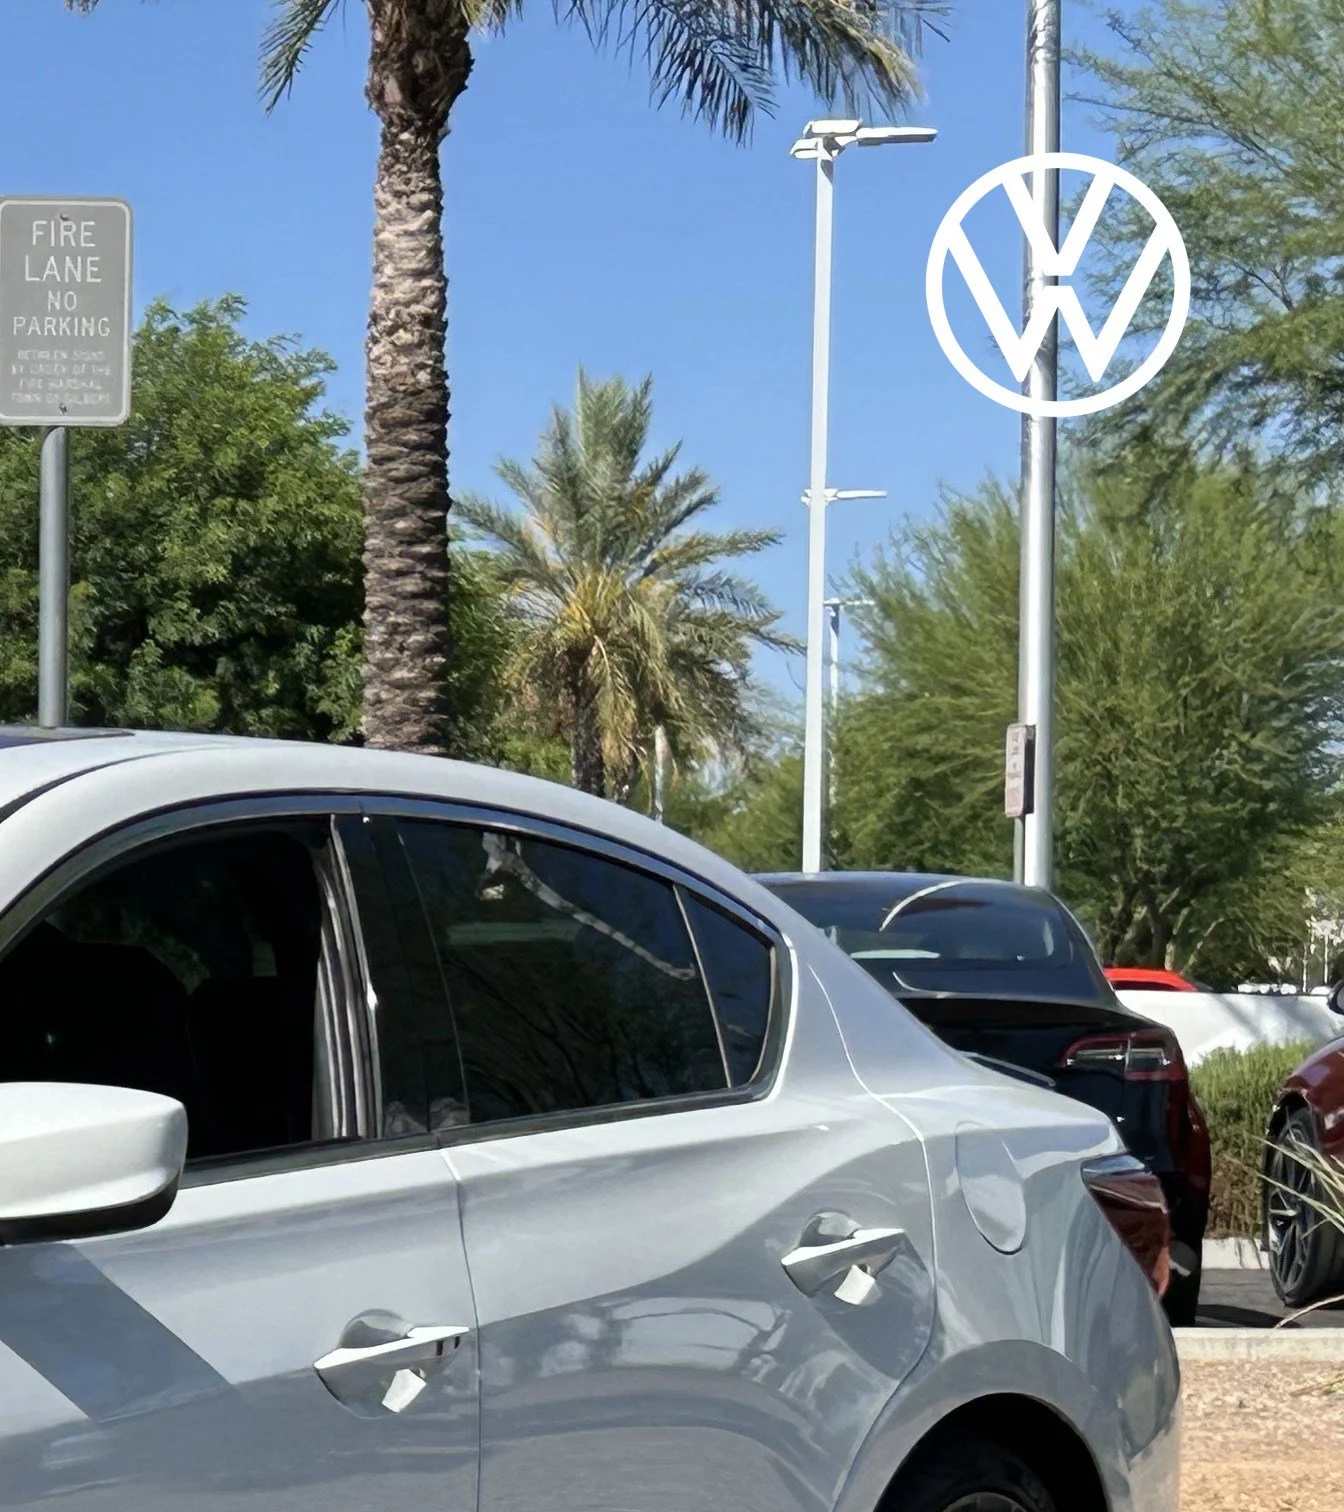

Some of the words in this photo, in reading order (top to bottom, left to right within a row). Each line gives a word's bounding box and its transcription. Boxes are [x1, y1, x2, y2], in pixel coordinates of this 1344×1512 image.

[32, 220, 96, 248] FIRE
[24, 254, 102, 283] LANE
[47, 290, 78, 312] NO
[12, 316, 111, 337] PARKING
